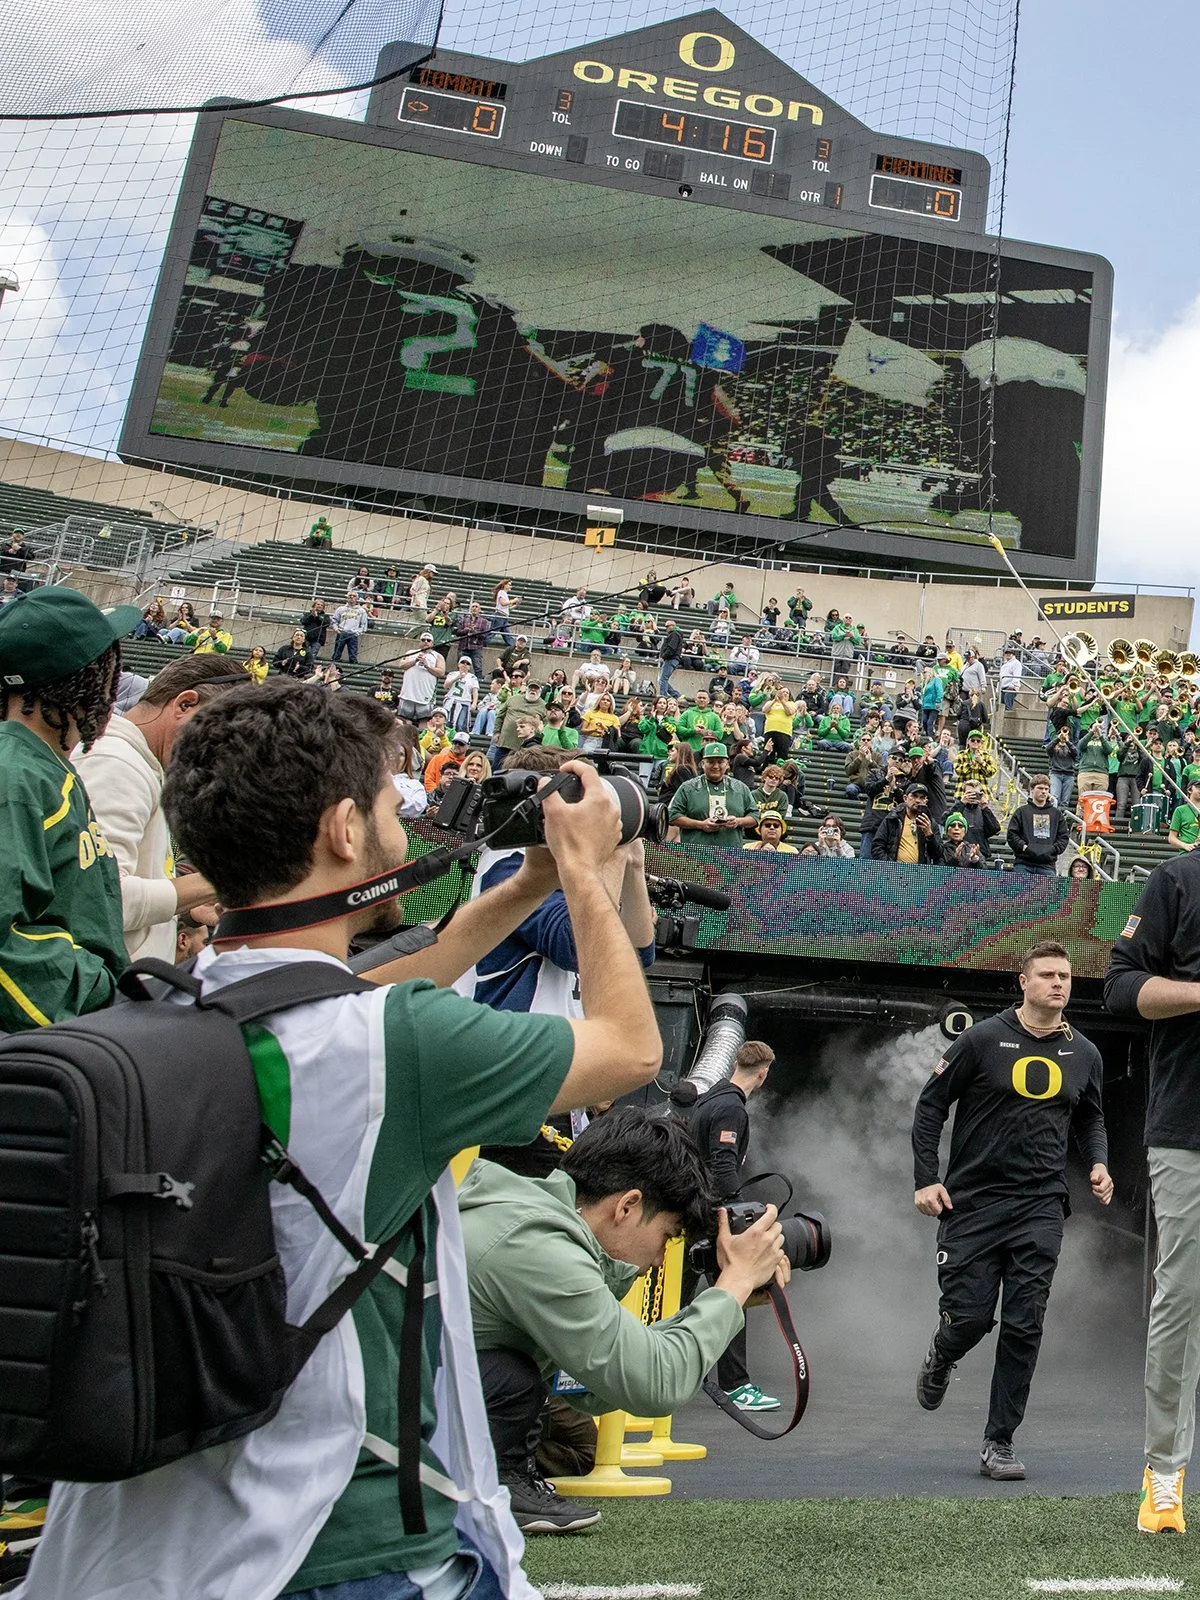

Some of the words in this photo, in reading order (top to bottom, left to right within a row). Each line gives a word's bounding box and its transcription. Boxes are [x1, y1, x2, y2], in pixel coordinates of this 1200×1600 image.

[679, 31, 736, 72] O
[419, 68, 496, 98] COMBAT
[573, 60, 824, 126] OREGON
[559, 91, 572, 111] 3
[472, 105, 497, 132] 0
[551, 112, 572, 125] TOL
[662, 112, 766, 159] 4:16
[530, 141, 563, 157] DOWN
[606, 154, 620, 167] TO
[625, 158, 640, 171] GO
[812, 160, 830, 173] TOL
[880, 154, 957, 184] FIGHTING
[700, 172, 728, 187] BALL
[733, 178, 748, 190] ON
[934, 190, 955, 216] 0
[398, 290, 479, 396] 2
[596, 530, 605, 543] 1
[1043, 600, 1130, 615] STUDENTS
[1091, 800, 1105, 814] G
[347, 877, 399, 906] Canon
[945, 1012, 974, 1035] O
[1012, 1055, 1063, 1099] O
[793, 1343, 806, 1379] Canon
